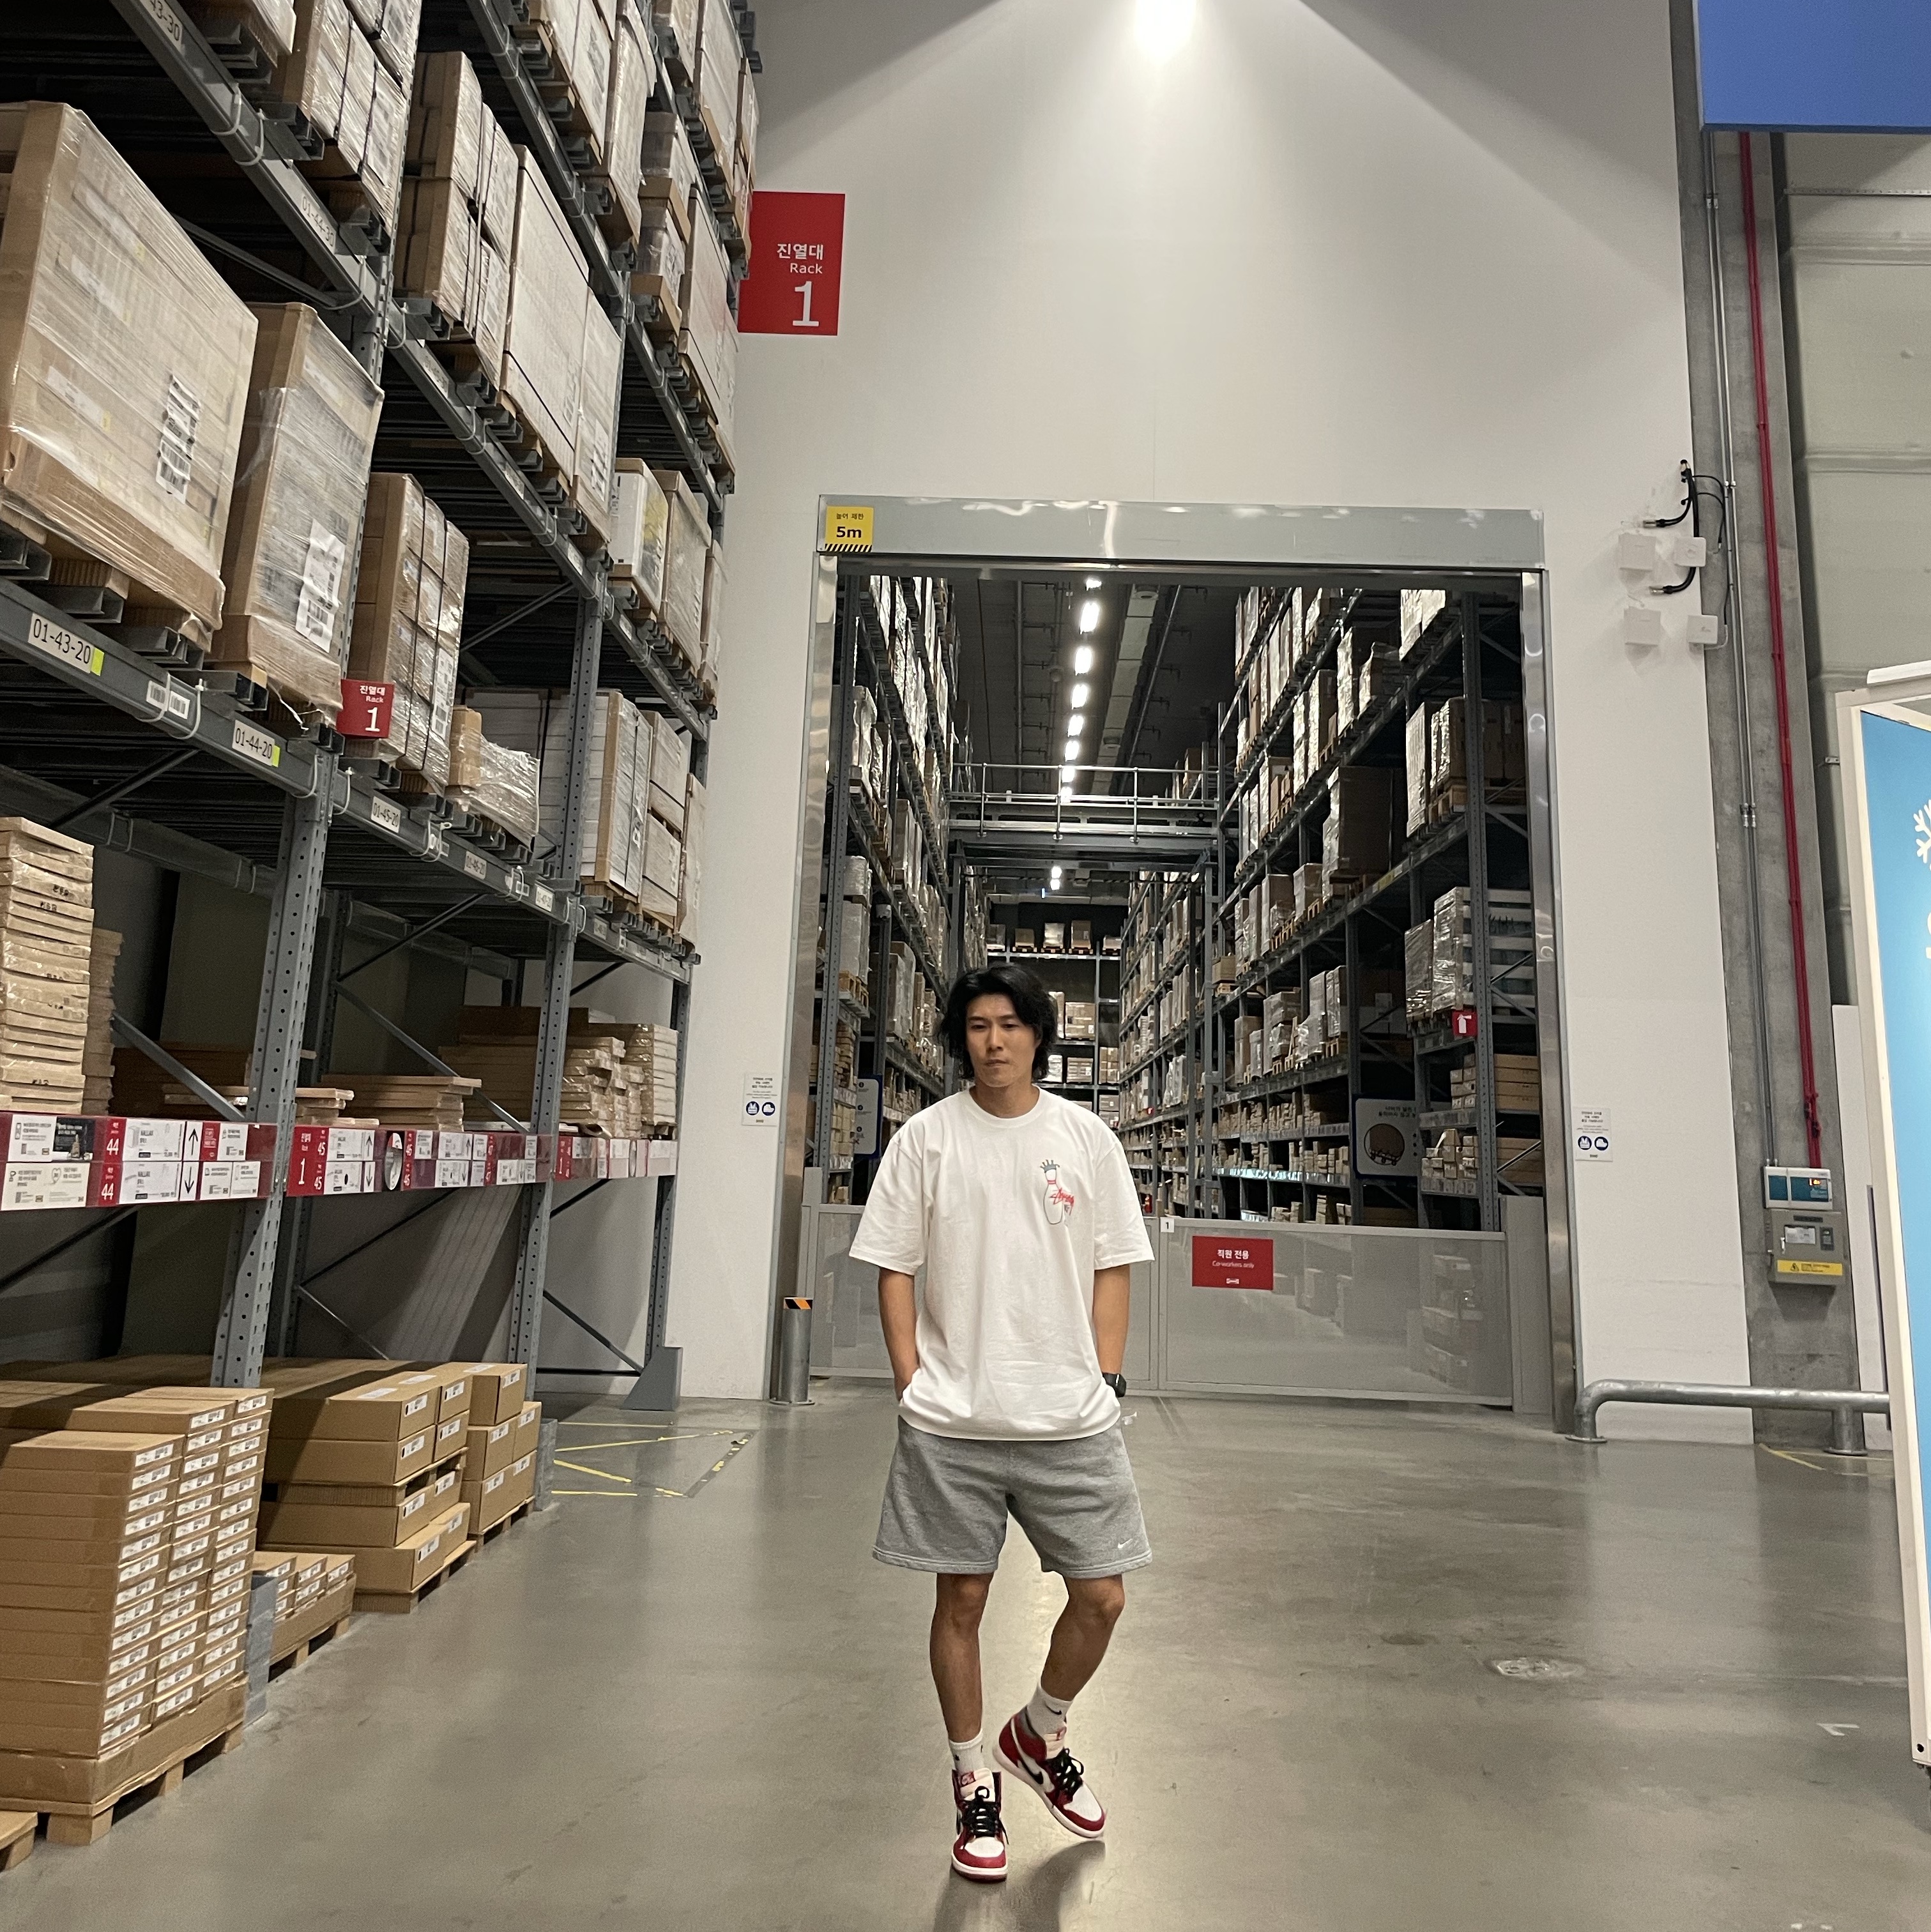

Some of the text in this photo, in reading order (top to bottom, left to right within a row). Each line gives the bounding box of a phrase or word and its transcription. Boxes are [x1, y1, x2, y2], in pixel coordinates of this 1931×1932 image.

[777, 243, 823, 261] 진열대
[790, 263, 823, 274] Rack
[793, 281, 820, 327] 1
[836, 526, 862, 538] 5m
[33, 618, 91, 664] 01-43-20
[360, 685, 386, 696] 진열대
[365, 706, 380, 732] 1
[235, 727, 273, 759] 01-44-20
[106, 1138, 119, 1155] 44
[317, 1141, 326, 1156] 45
[298, 1158, 305, 1185] 1
[314, 1176, 323, 1190] 45
[101, 1183, 114, 1201] 44
[1165, 1222, 1170, 1230] 1
[1217, 1249, 1249, 1260] 직원 전용
